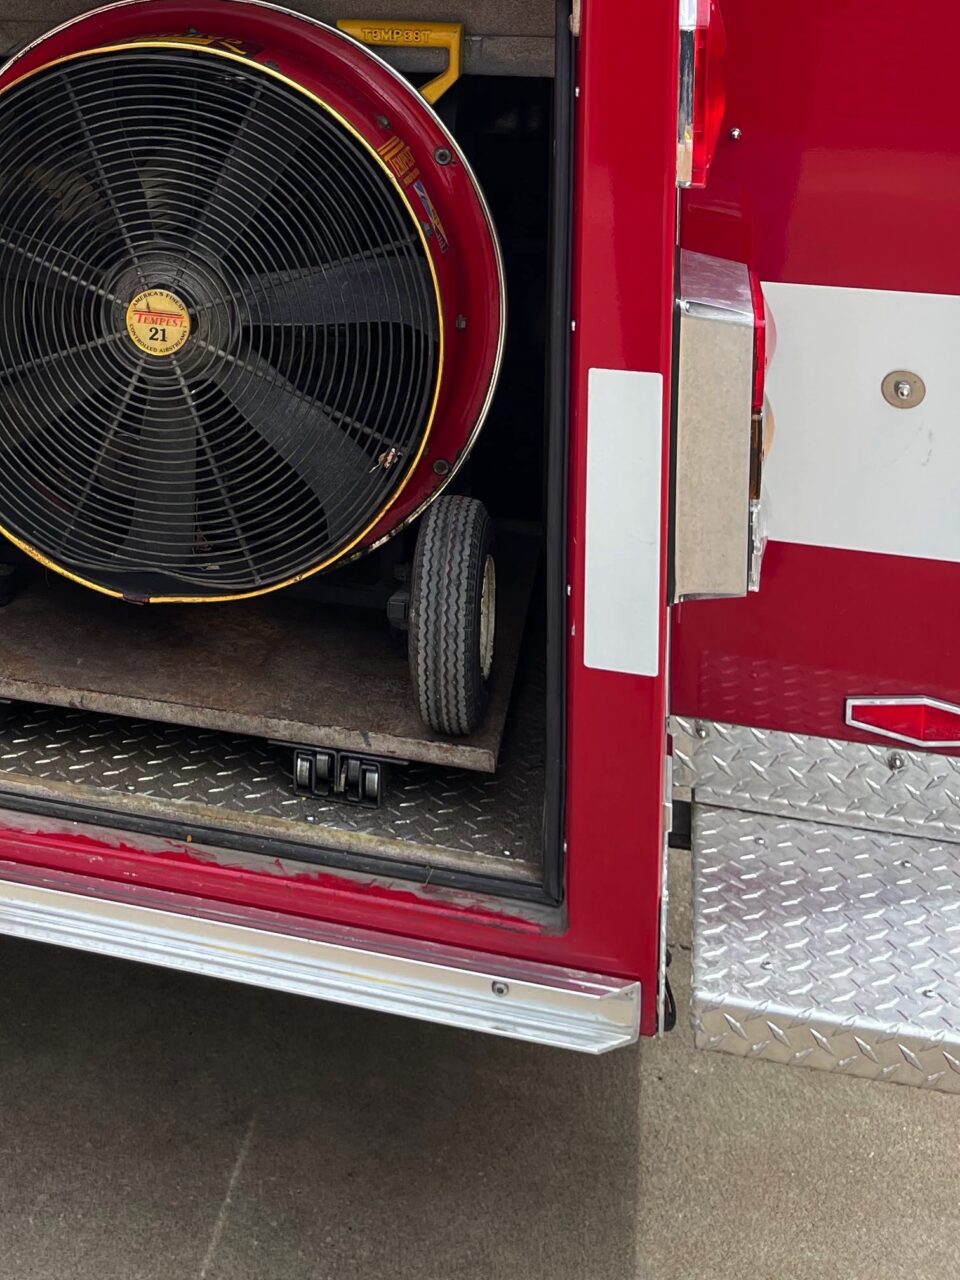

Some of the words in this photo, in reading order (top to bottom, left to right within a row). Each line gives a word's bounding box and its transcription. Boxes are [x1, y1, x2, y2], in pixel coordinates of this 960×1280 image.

[362, 27, 431, 42] TEMPEST
[133, 291, 164, 308] AMERICA'S
[165, 293, 186, 312] FINEST
[135, 313, 184, 328] TEMPEST
[129, 323, 158, 353] CONTROLLED
[159, 329, 188, 353] AIRSTREAMS
[148, 326, 168, 342] 21
